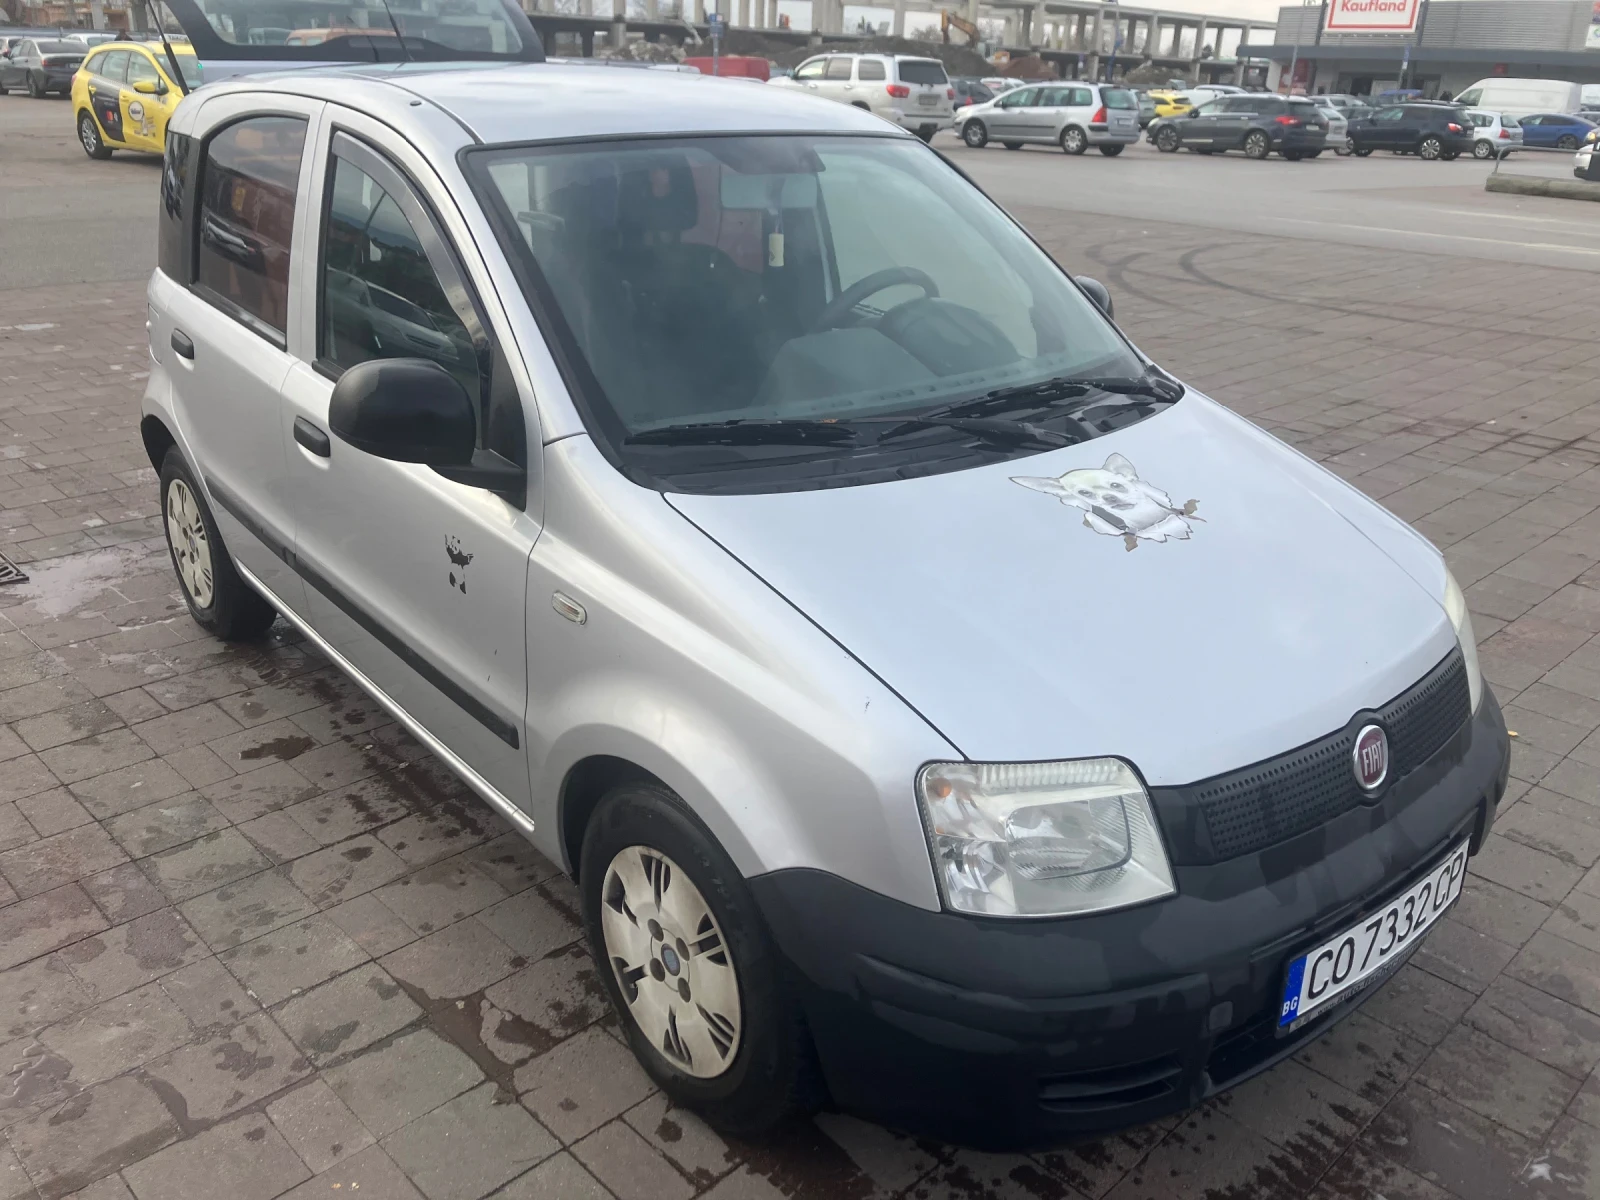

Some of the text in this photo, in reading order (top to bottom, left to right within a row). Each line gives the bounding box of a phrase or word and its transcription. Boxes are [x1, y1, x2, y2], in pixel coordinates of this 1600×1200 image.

[1341, 0, 1406, 12] Kaufland
[1362, 741, 1382, 777] FIAT
[1282, 996, 1298, 1016] BG
